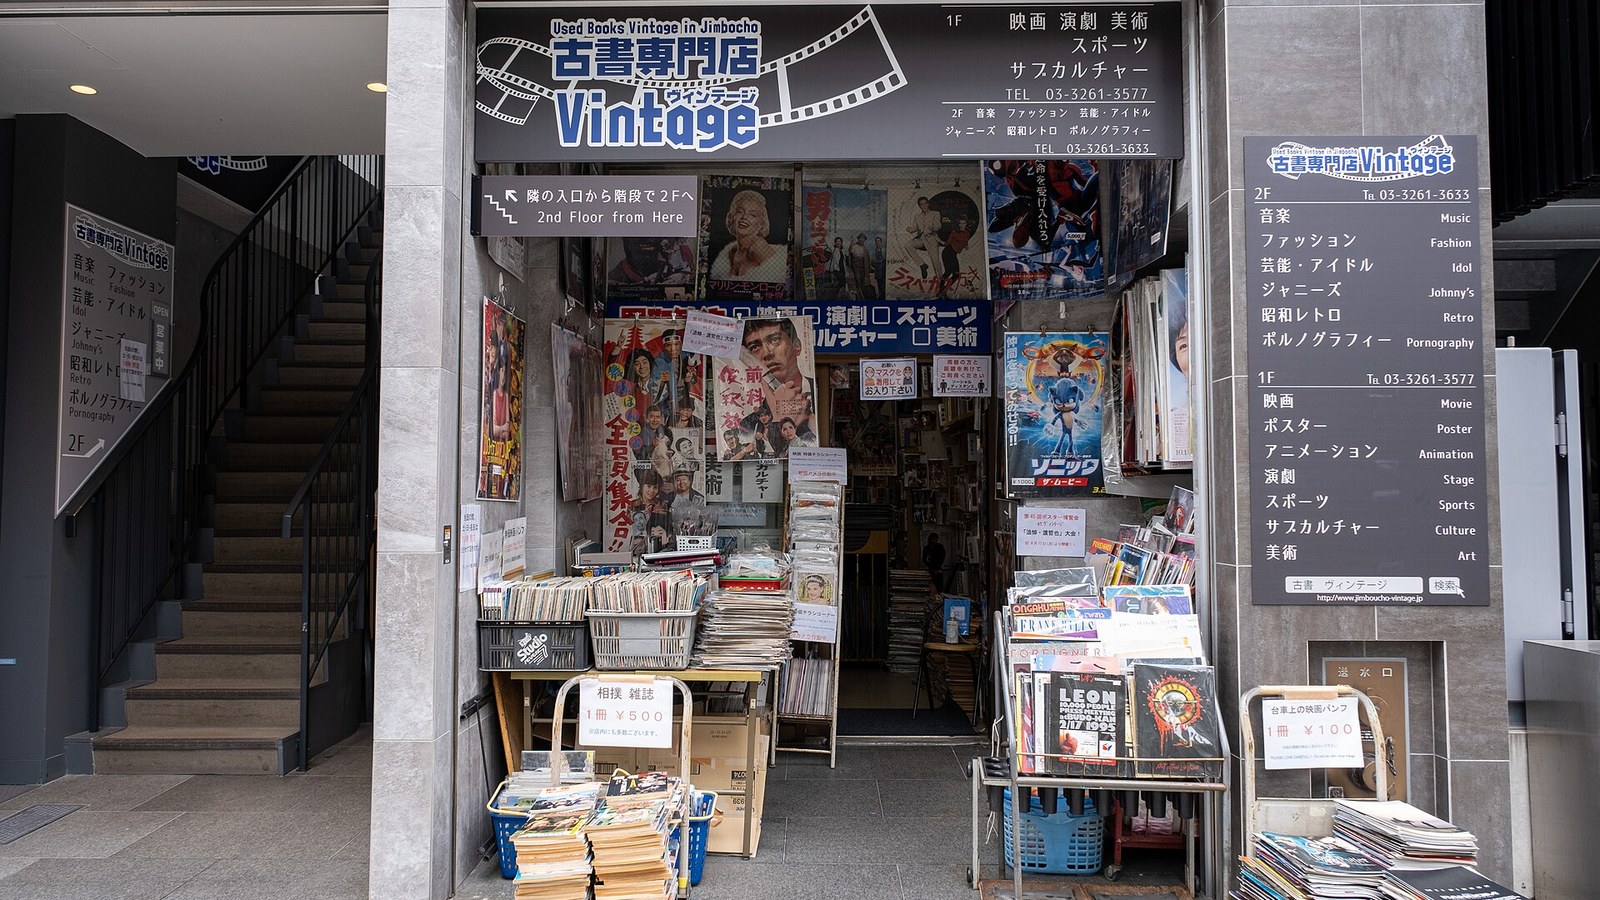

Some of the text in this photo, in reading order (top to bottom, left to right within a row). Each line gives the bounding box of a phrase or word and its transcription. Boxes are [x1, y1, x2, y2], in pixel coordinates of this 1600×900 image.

[552, 19, 760, 38] Used Books Vintage in Jimbocho
[945, 14, 962, 27] 1F
[1009, 11, 1149, 31] 映画 演劇 美術
[1071, 35, 1148, 55] スポーツ
[552, 35, 761, 78] 古書専門店
[1010, 61, 1149, 80] サブカルチャー
[665, 86, 759, 105] ヴィンテージ
[1005, 87, 1148, 101] TEL 03-3261-3577
[555, 88, 761, 151] Vintage
[951, 107, 1151, 119] 2F 音楽 ファッション 芸能・アイドル
[945, 125, 1151, 138] ジャニーズ 昭和レトロ ポルノグラフィー
[1034, 143, 1149, 154] TEL 03-3261-3633
[1272, 148, 1453, 175] 古書専門店 Vintage
[1254, 187, 1272, 201] 2F
[1379, 189, 1470, 201] 03-3261-3633
[537, 210, 684, 224] 2nd Floor from Here
[1259, 207, 1471, 224] 音楽 Music
[76, 223, 124, 254] 古書専門店
[124, 236, 169, 272] Vintage
[1260, 233, 1472, 249] ファッション Fashion
[73, 253, 166, 295] 音楽 ファッション
[1260, 257, 1472, 274] 芸能・アイドル Idol
[73, 271, 136, 298] Music Fashion
[1261, 282, 1475, 298] ジャニーズ Johnny's
[72, 286, 147, 320] 芸能・アイドル
[72, 304, 87, 317] Idol
[153, 305, 170, 318] OPEN
[826, 305, 868, 326] 演劇
[896, 305, 978, 326] スポーツ
[1261, 307, 1474, 323] 昭和レトロ Retro
[71, 321, 126, 346] ジャニーズ
[936, 327, 978, 348] 美術
[1262, 331, 1475, 349] ポルノグラフィー Pornography
[71, 339, 104, 356] Johnny's
[154, 323, 166, 370] 営業中
[70, 372, 92, 385] Retro
[876, 368, 902, 377] マスクを
[1257, 371, 1276, 384] 1F
[1384, 373, 1475, 385] 03-3261-3577
[864, 385, 914, 396] お入り下さい
[1263, 393, 1473, 409] 映画 Movie
[69, 406, 115, 424] Pornography
[1263, 418, 1473, 435] ポスター Poster
[68, 433, 85, 452] 2F
[1264, 443, 1474, 460] アニメーション Animation
[1032, 458, 1100, 477] ソニック
[1042, 478, 1082, 486] ザ・ムービー
[1264, 468, 1475, 487] 演劇 Stage
[1265, 493, 1475, 511] スポーツ Sports
[1265, 519, 1476, 536] サブカルチャー Culture
[1266, 544, 1477, 561] 美術 Art
[1292, 579, 1457, 591] 古書 ヴィンテージ 検索
[1012, 603, 1050, 613] ONGAKU
[516, 632, 549, 663] Studio
[1010, 647, 1101, 658] FOREIGNER
[1337, 667, 1394, 678] 送水口
[596, 686, 655, 701] 相撲 雑誌
[1059, 687, 1116, 704] LEON
[1059, 701, 1116, 711] 10,000 PEOPLE
[1084, 709, 1116, 717] MEETING
[1270, 703, 1348, 716] 台車上の映画パンフ
[585, 708, 664, 722] 1冊 ¥500
[1059, 720, 1116, 732] 2/17 1995
[1266, 723, 1354, 738] 1冊 ¥100
